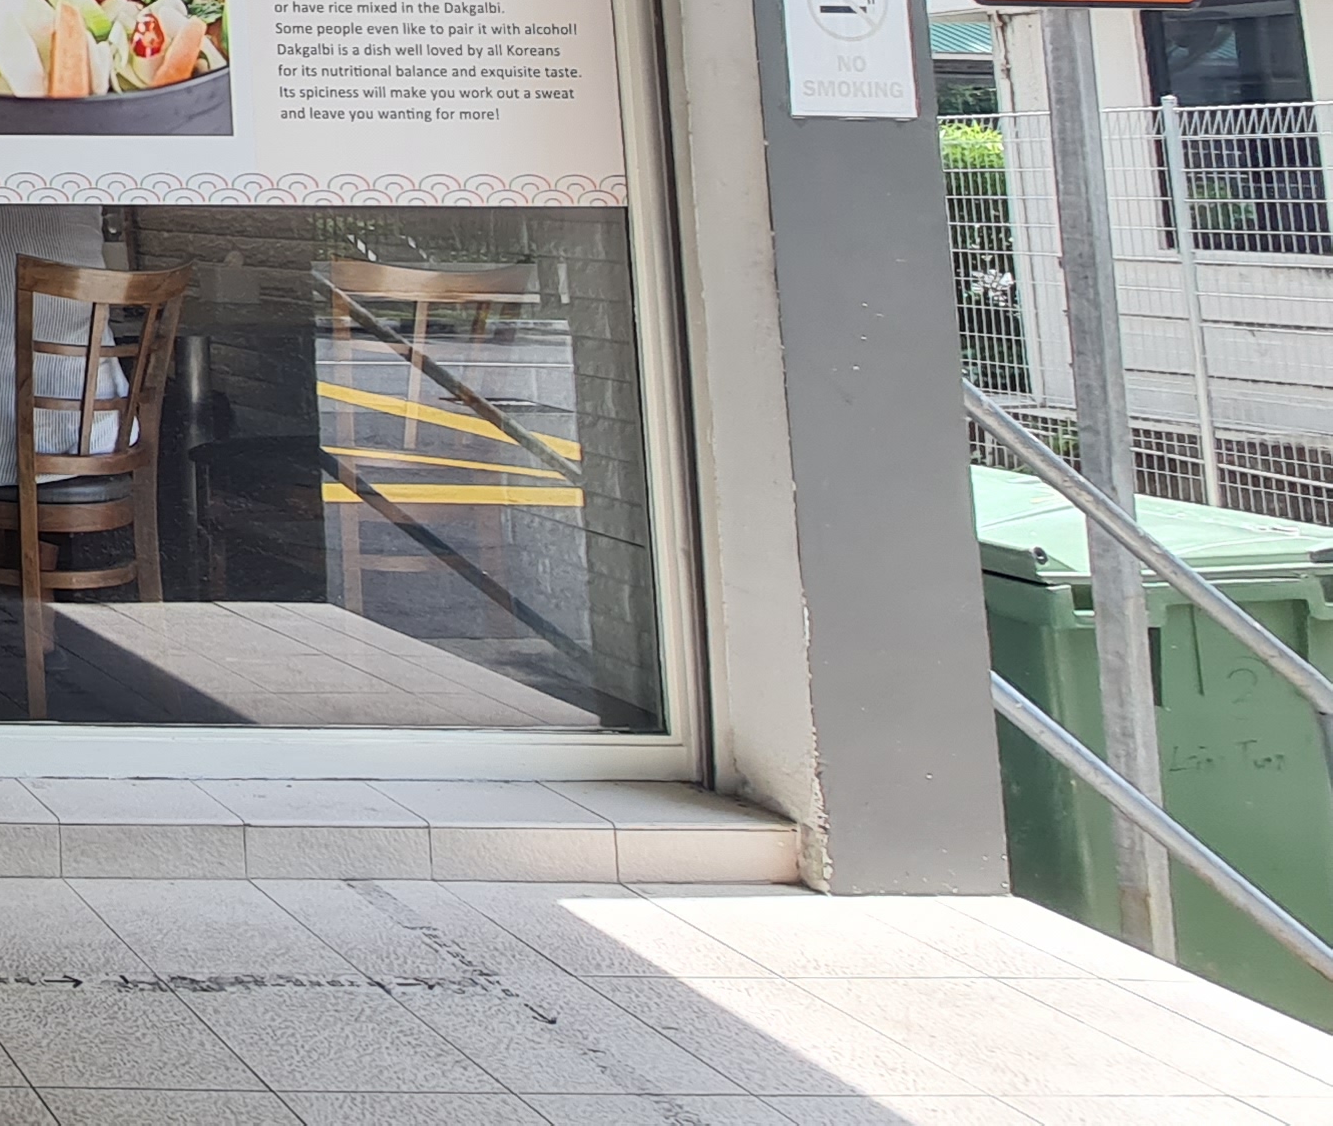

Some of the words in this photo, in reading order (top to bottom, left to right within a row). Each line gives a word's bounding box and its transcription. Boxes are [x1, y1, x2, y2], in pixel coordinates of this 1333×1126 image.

[836, 55, 867, 72] NO
[802, 80, 904, 98] SMOKING
[280, 107, 306, 120] and
[309, 107, 345, 120] leave
[348, 110, 374, 122] you
[377, 107, 432, 123] wanting
[435, 107, 455, 120] for
[459, 108, 500, 120] more!
